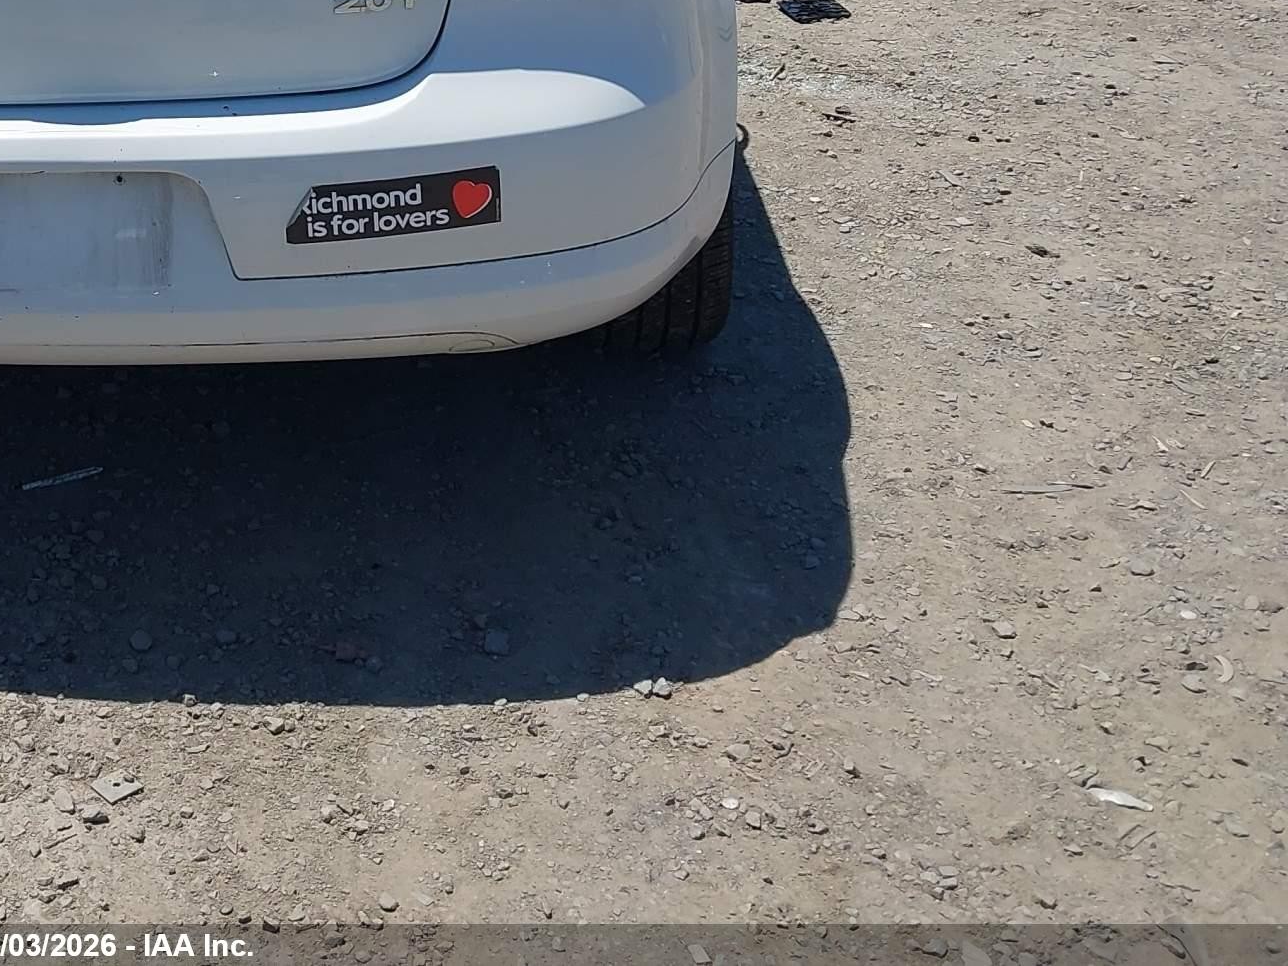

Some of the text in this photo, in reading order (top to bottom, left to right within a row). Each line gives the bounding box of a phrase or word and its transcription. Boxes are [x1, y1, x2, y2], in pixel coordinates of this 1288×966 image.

[306, 208, 450, 238] is for lovers
